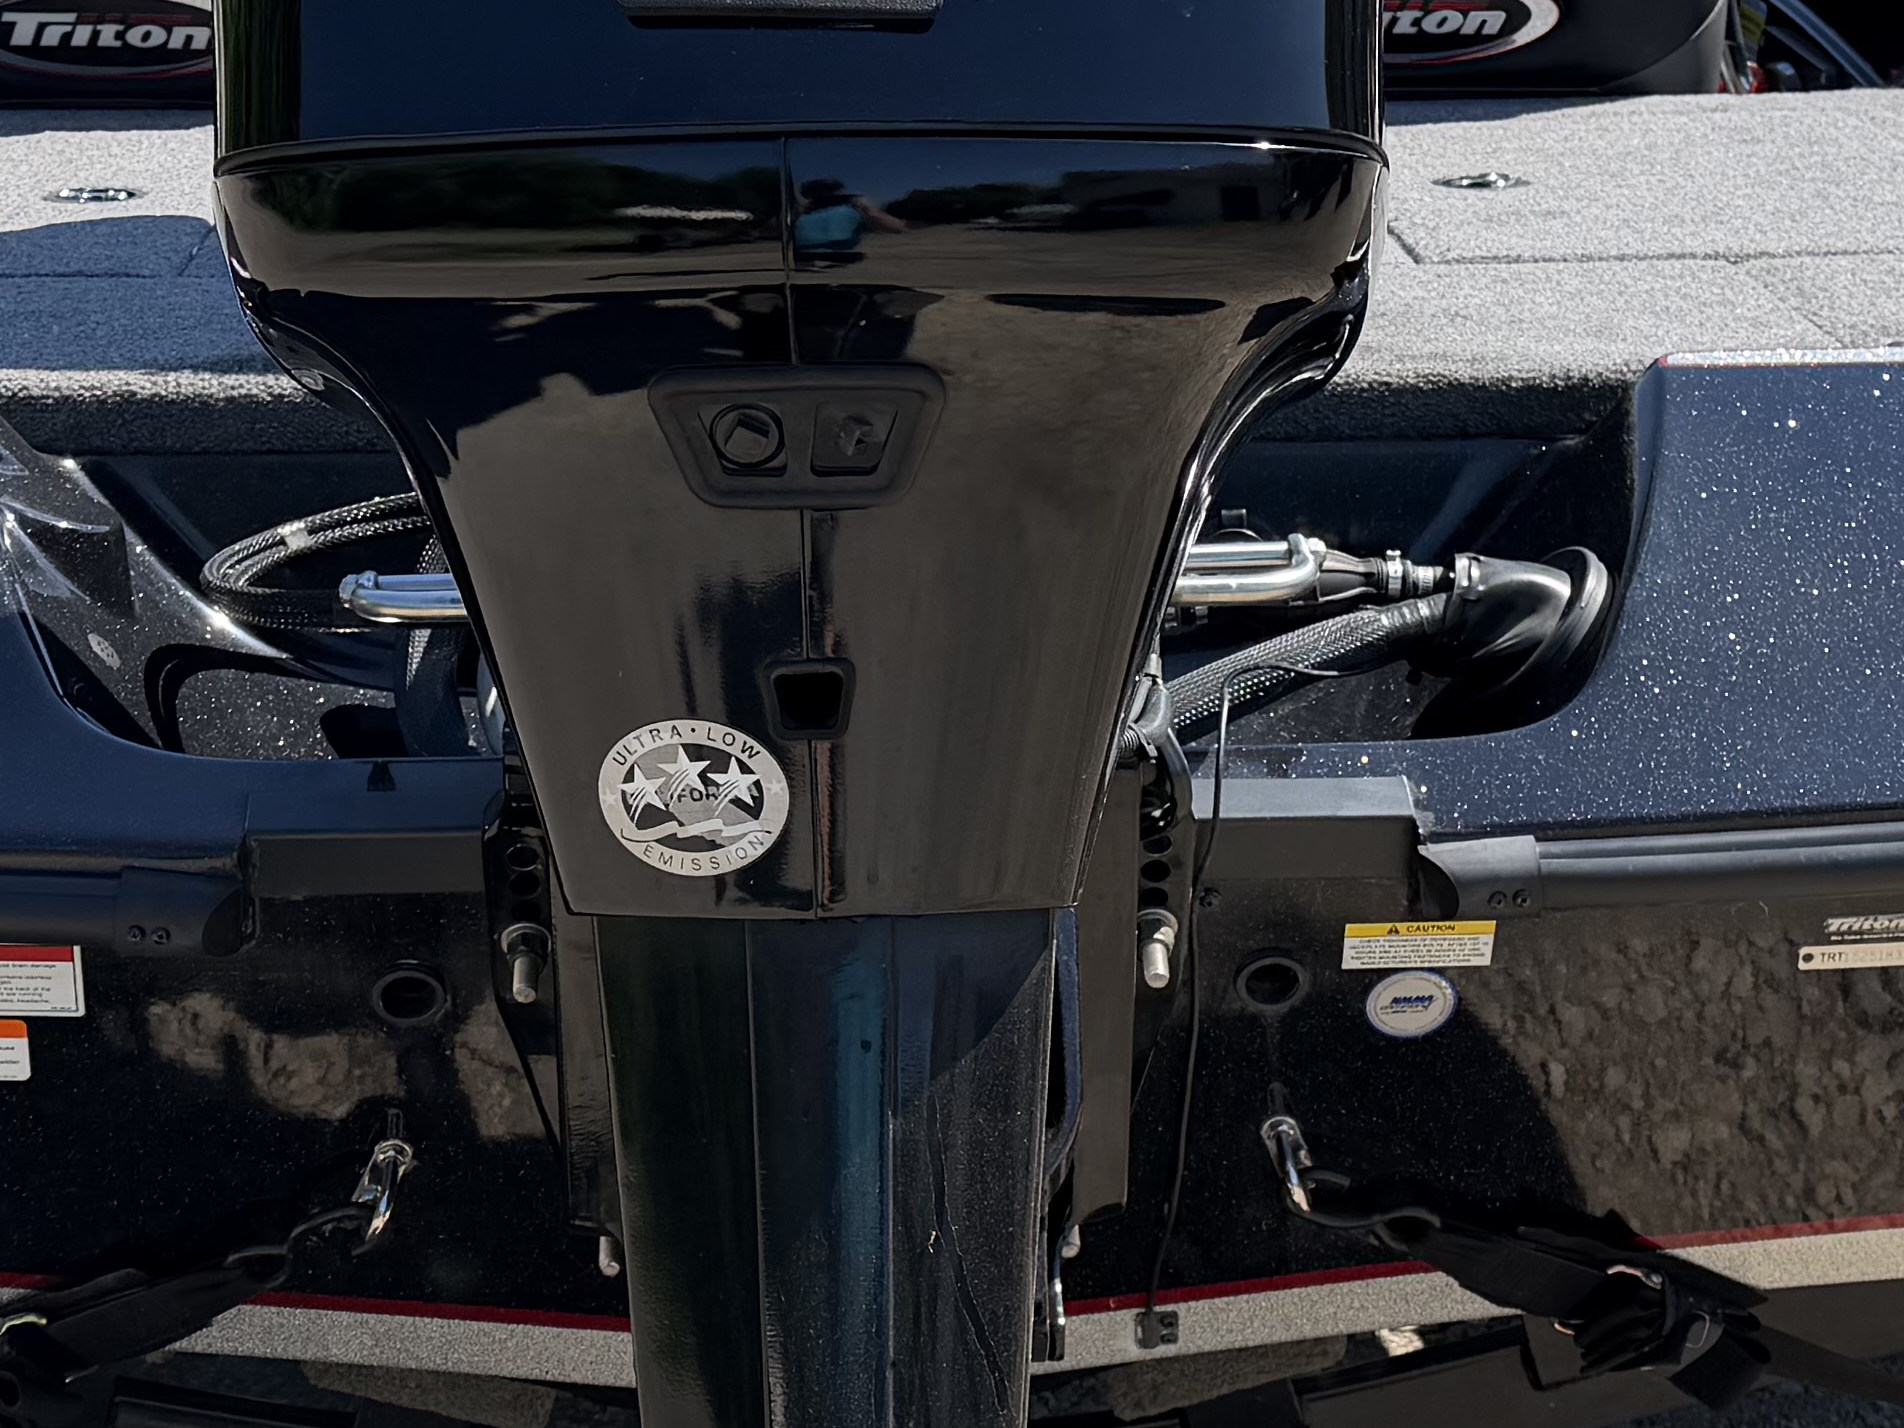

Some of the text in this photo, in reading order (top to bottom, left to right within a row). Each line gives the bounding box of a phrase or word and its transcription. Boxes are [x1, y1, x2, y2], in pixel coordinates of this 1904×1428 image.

[1, 11, 212, 50] Triton
[612, 724, 761, 767] ULTRA LOW
[643, 835, 765, 871] EMISSION
[1406, 924, 1456, 933] CAUTION
